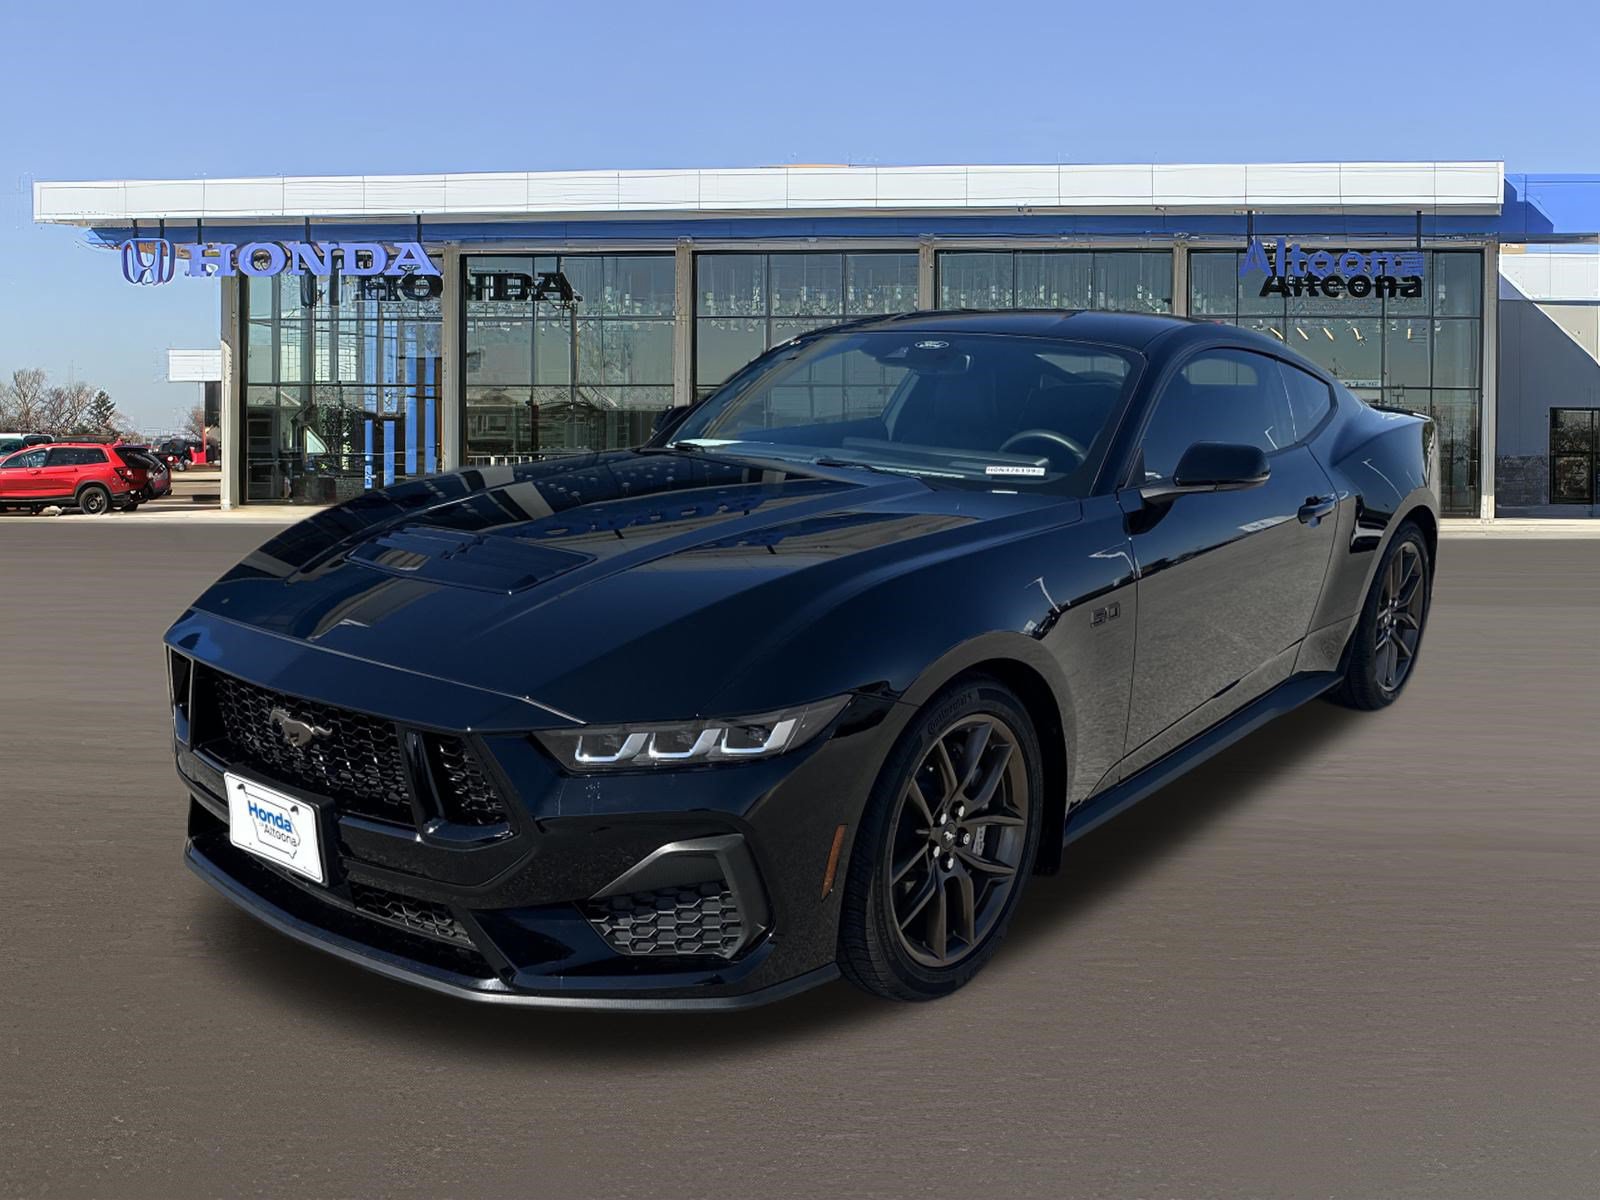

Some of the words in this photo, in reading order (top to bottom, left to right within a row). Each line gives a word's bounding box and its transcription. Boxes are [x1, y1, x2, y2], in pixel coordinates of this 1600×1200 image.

[185, 241, 444, 278] HONDA
[248, 799, 293, 834] Honda
[264, 824, 298, 848] Altoona
